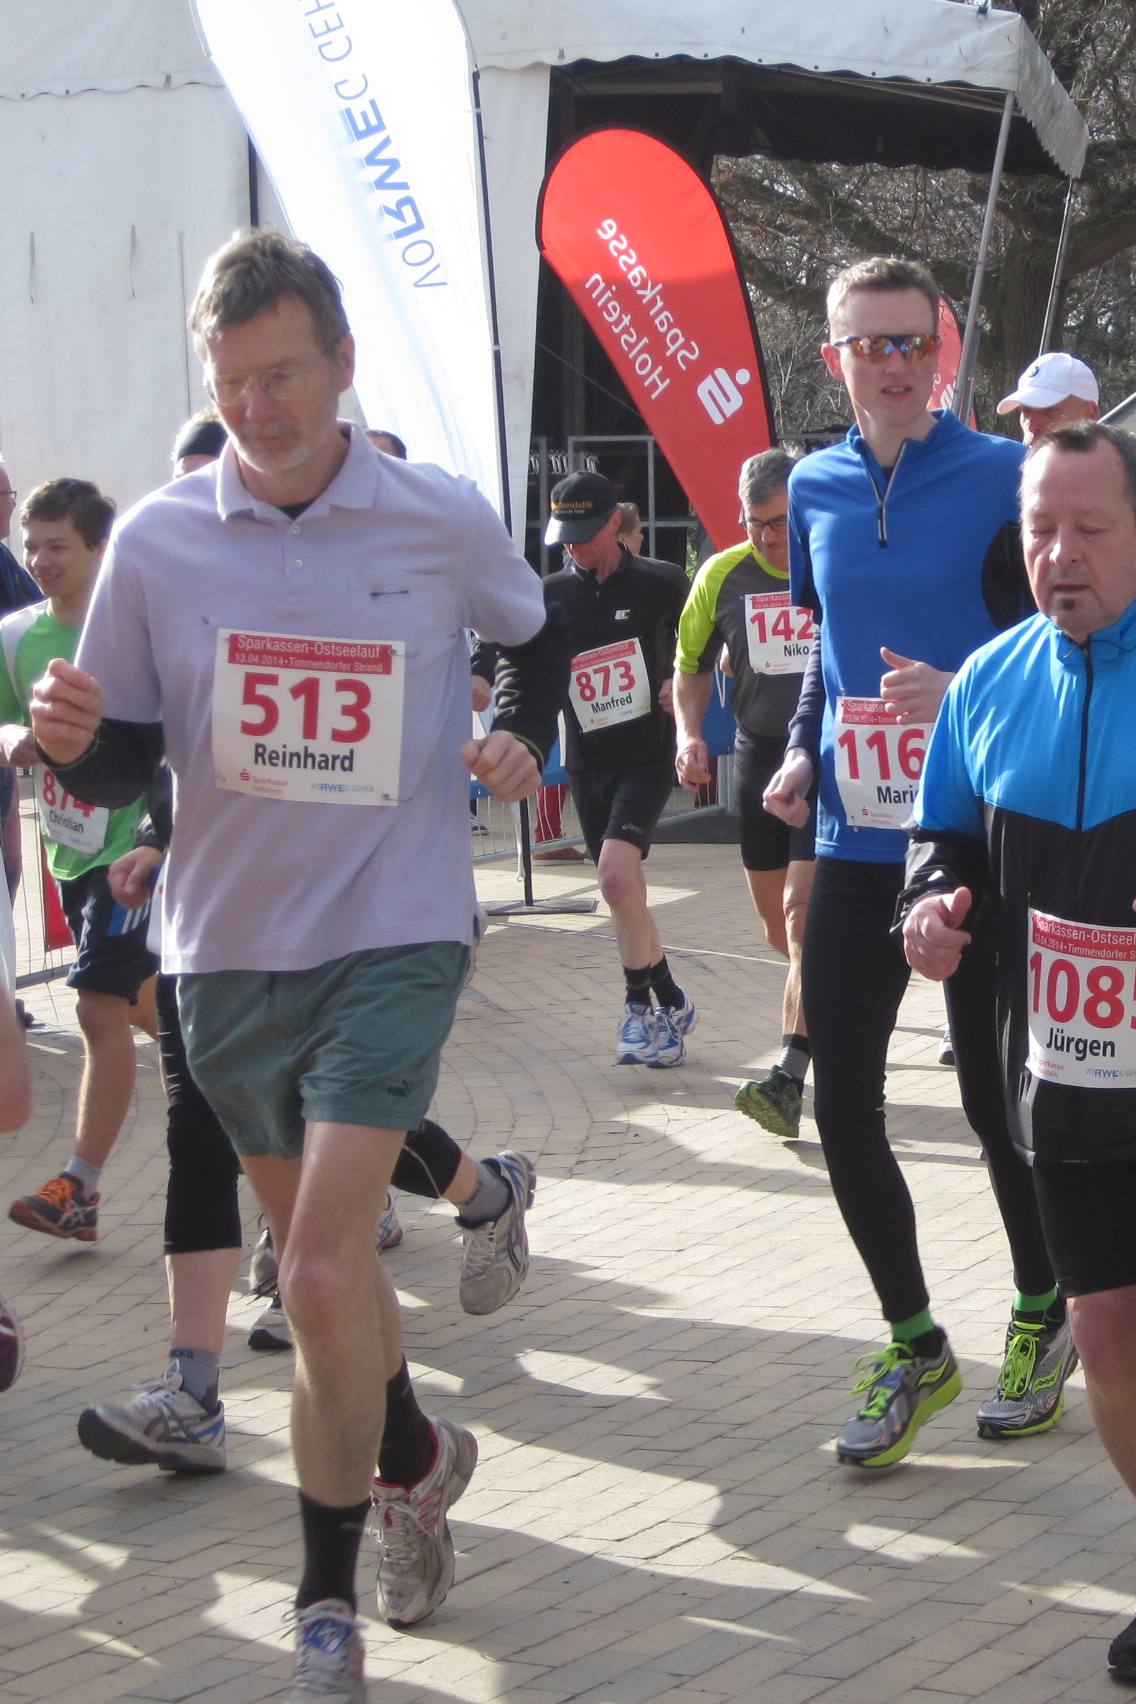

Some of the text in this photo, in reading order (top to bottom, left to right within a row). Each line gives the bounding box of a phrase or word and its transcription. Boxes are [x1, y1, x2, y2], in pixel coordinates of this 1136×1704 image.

[237, 634, 381, 658] Sparkassen-Ostseelauf
[235, 653, 383, 673] 13.04.2014 Timmendorfer Strand
[575, 660, 636, 702] 873
[240, 671, 372, 744] 513
[590, 692, 633, 715] Manfred
[254, 742, 354, 772] Reinhard
[838, 728, 933, 781] 116
[877, 785, 920, 804] Mari
[49, 809, 84, 834] Christian
[1034, 933, 1064, 951] 13.04.2014
[1067, 943, 1127, 960] Timmendorfer
[1046, 1027, 1116, 1062] Jürgen
